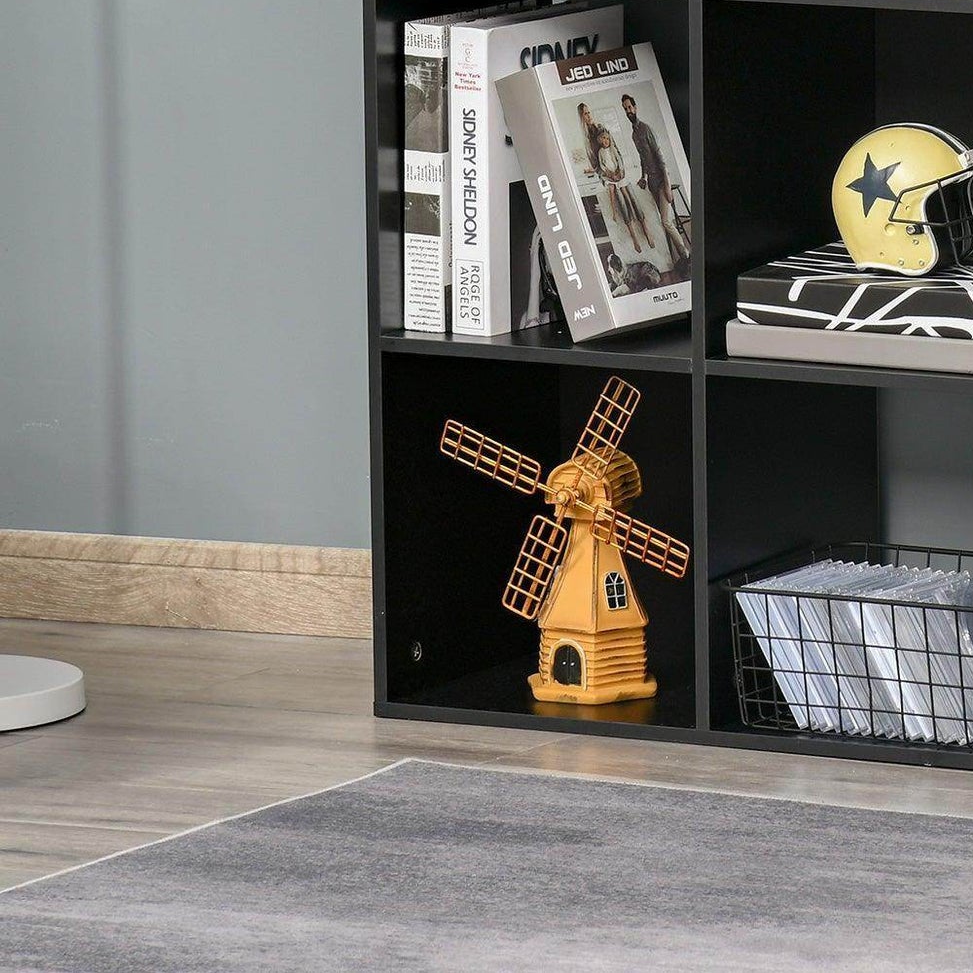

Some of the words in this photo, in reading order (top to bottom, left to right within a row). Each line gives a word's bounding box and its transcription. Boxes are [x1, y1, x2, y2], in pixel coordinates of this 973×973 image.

[566, 65, 593, 82] JED
[597, 57, 629, 76] LIND
[463, 107, 477, 165] SIDNEY
[463, 168, 477, 246] SHELDON
[537, 174, 563, 232] LIND
[558, 240, 583, 291] JED
[460, 266, 470, 320] ANGELS
[470, 308, 481, 325] OF
[573, 304, 597, 322] NEW
